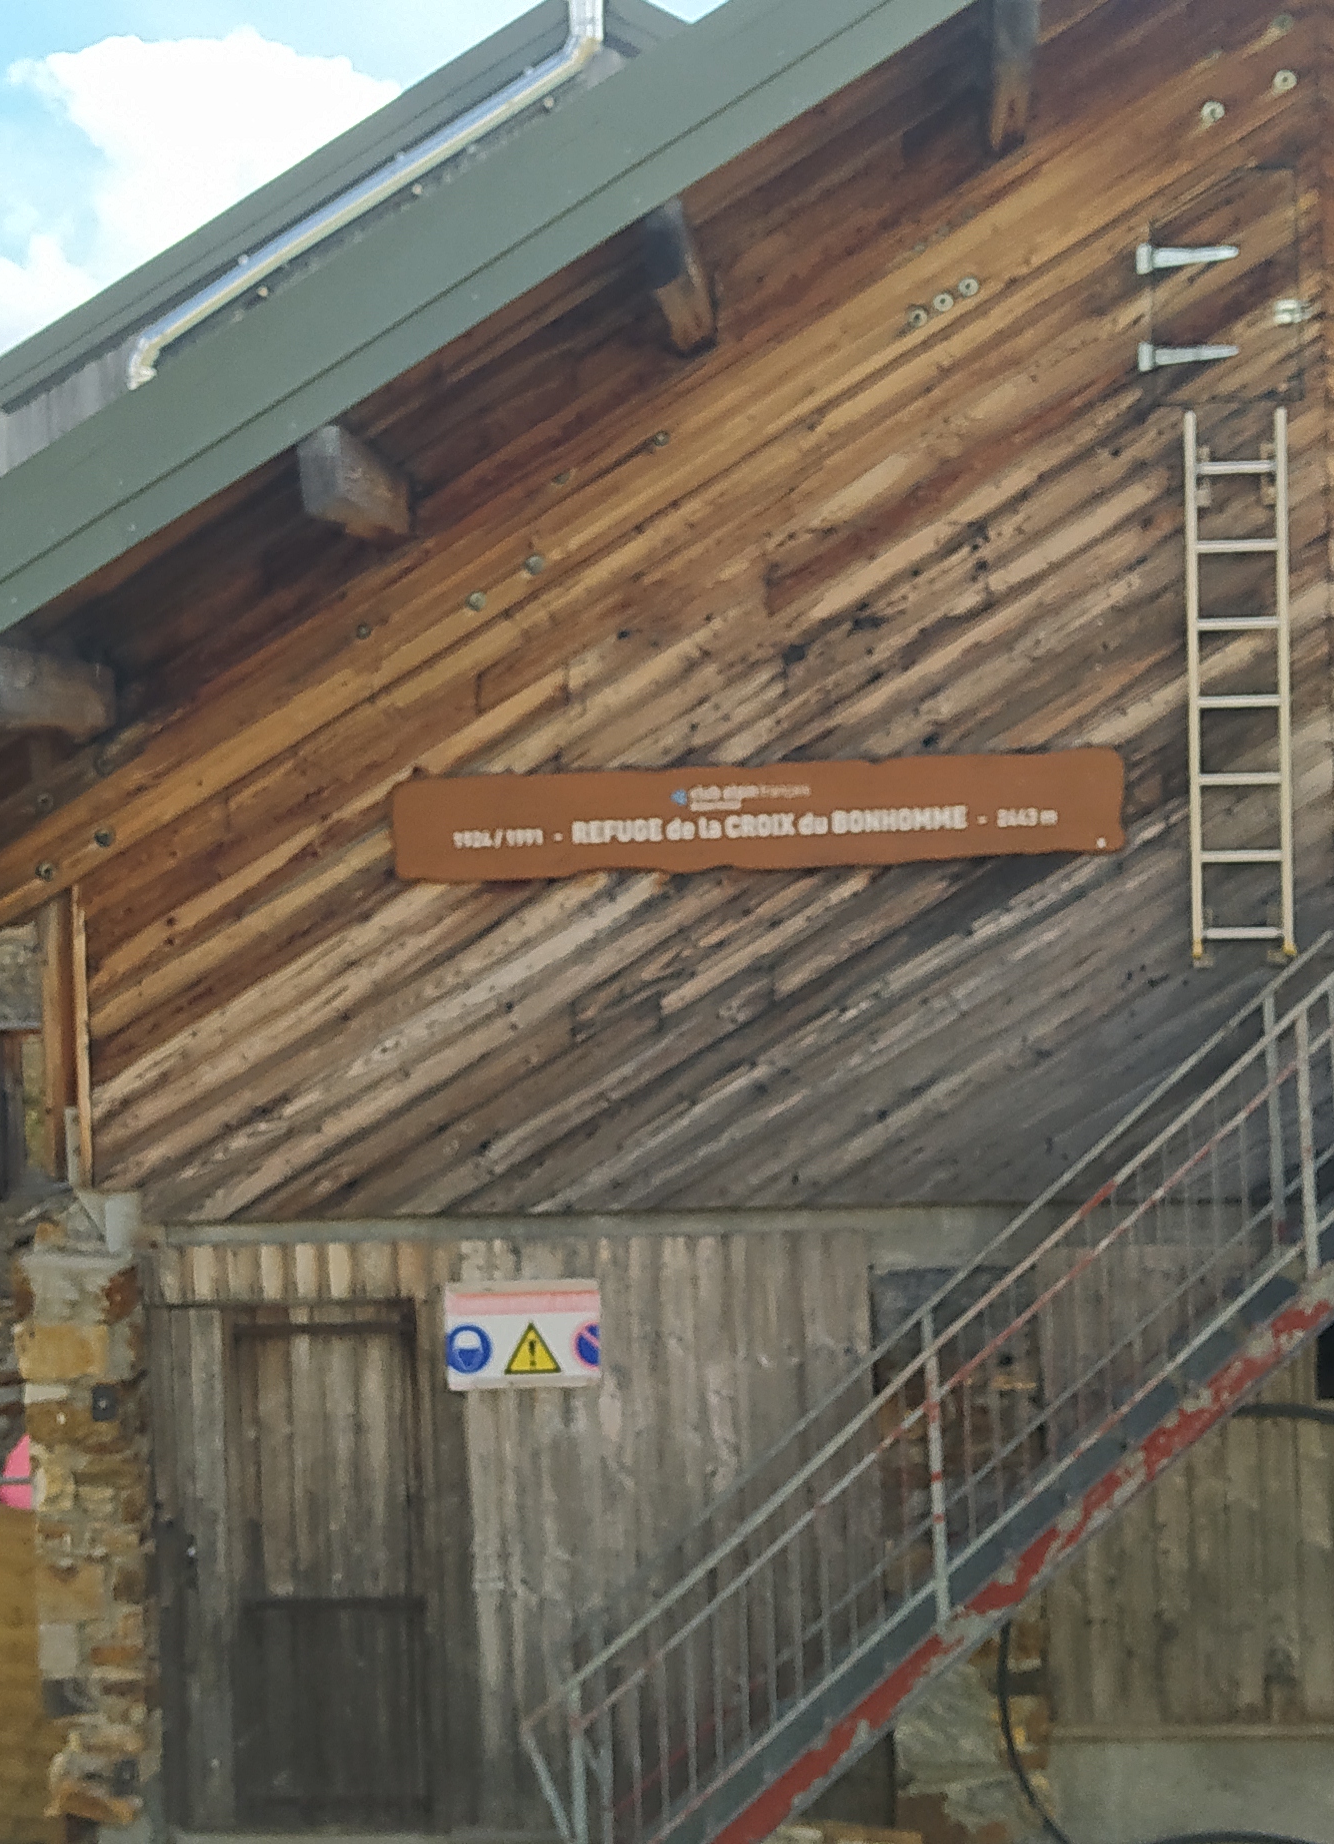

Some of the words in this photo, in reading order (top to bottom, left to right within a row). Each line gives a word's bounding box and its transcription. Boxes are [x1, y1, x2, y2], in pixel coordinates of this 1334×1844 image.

[571, 817, 663, 844] REFUGE
[666, 817, 695, 841] de
[698, 816, 722, 840] la
[724, 812, 796, 838] CROIX
[798, 811, 828, 836] du
[831, 804, 968, 835] BONHOMME
